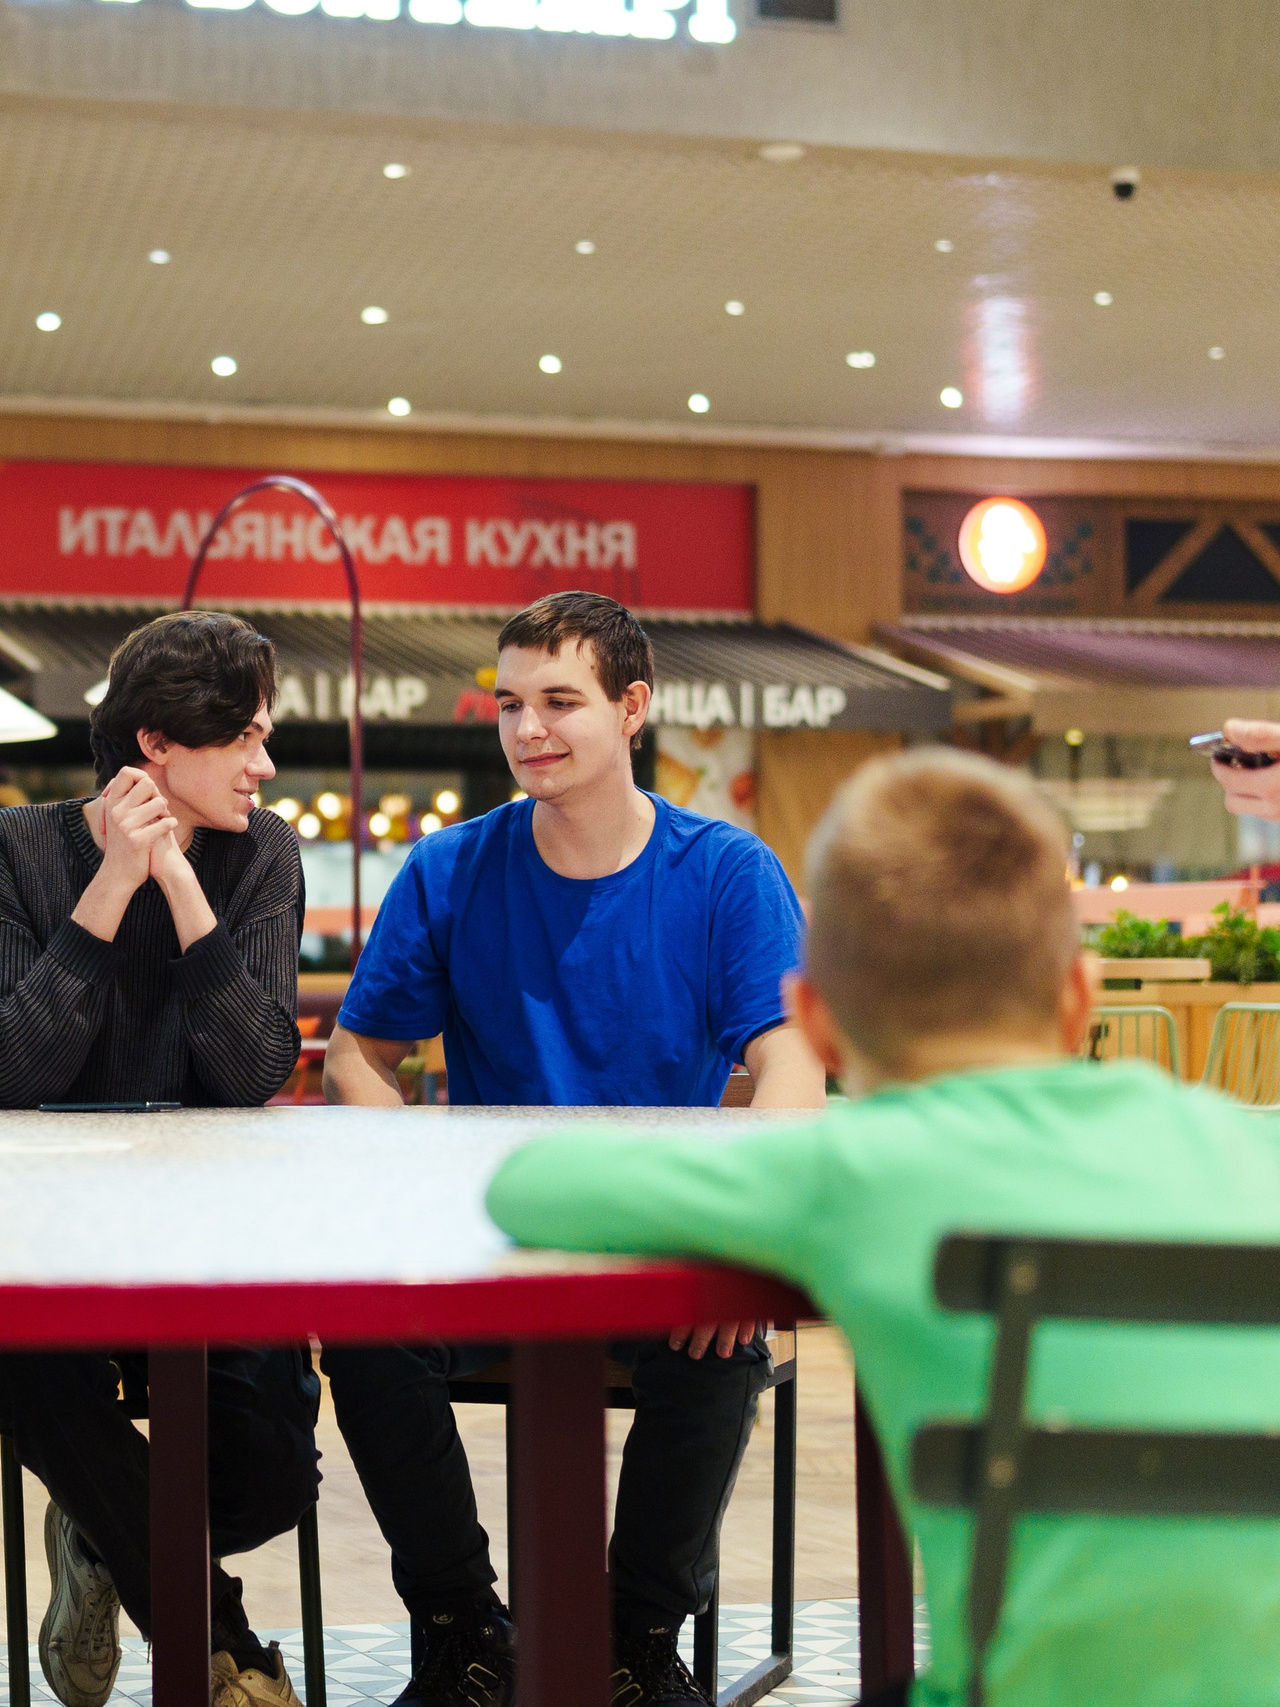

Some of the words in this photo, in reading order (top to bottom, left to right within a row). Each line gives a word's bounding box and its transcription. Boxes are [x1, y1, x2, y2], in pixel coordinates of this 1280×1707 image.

[58, 507, 451, 566] ИТАЛЬЯНСКАЯ
[465, 516, 638, 569] КУХНЯ
[763, 684, 847, 728] БАР
